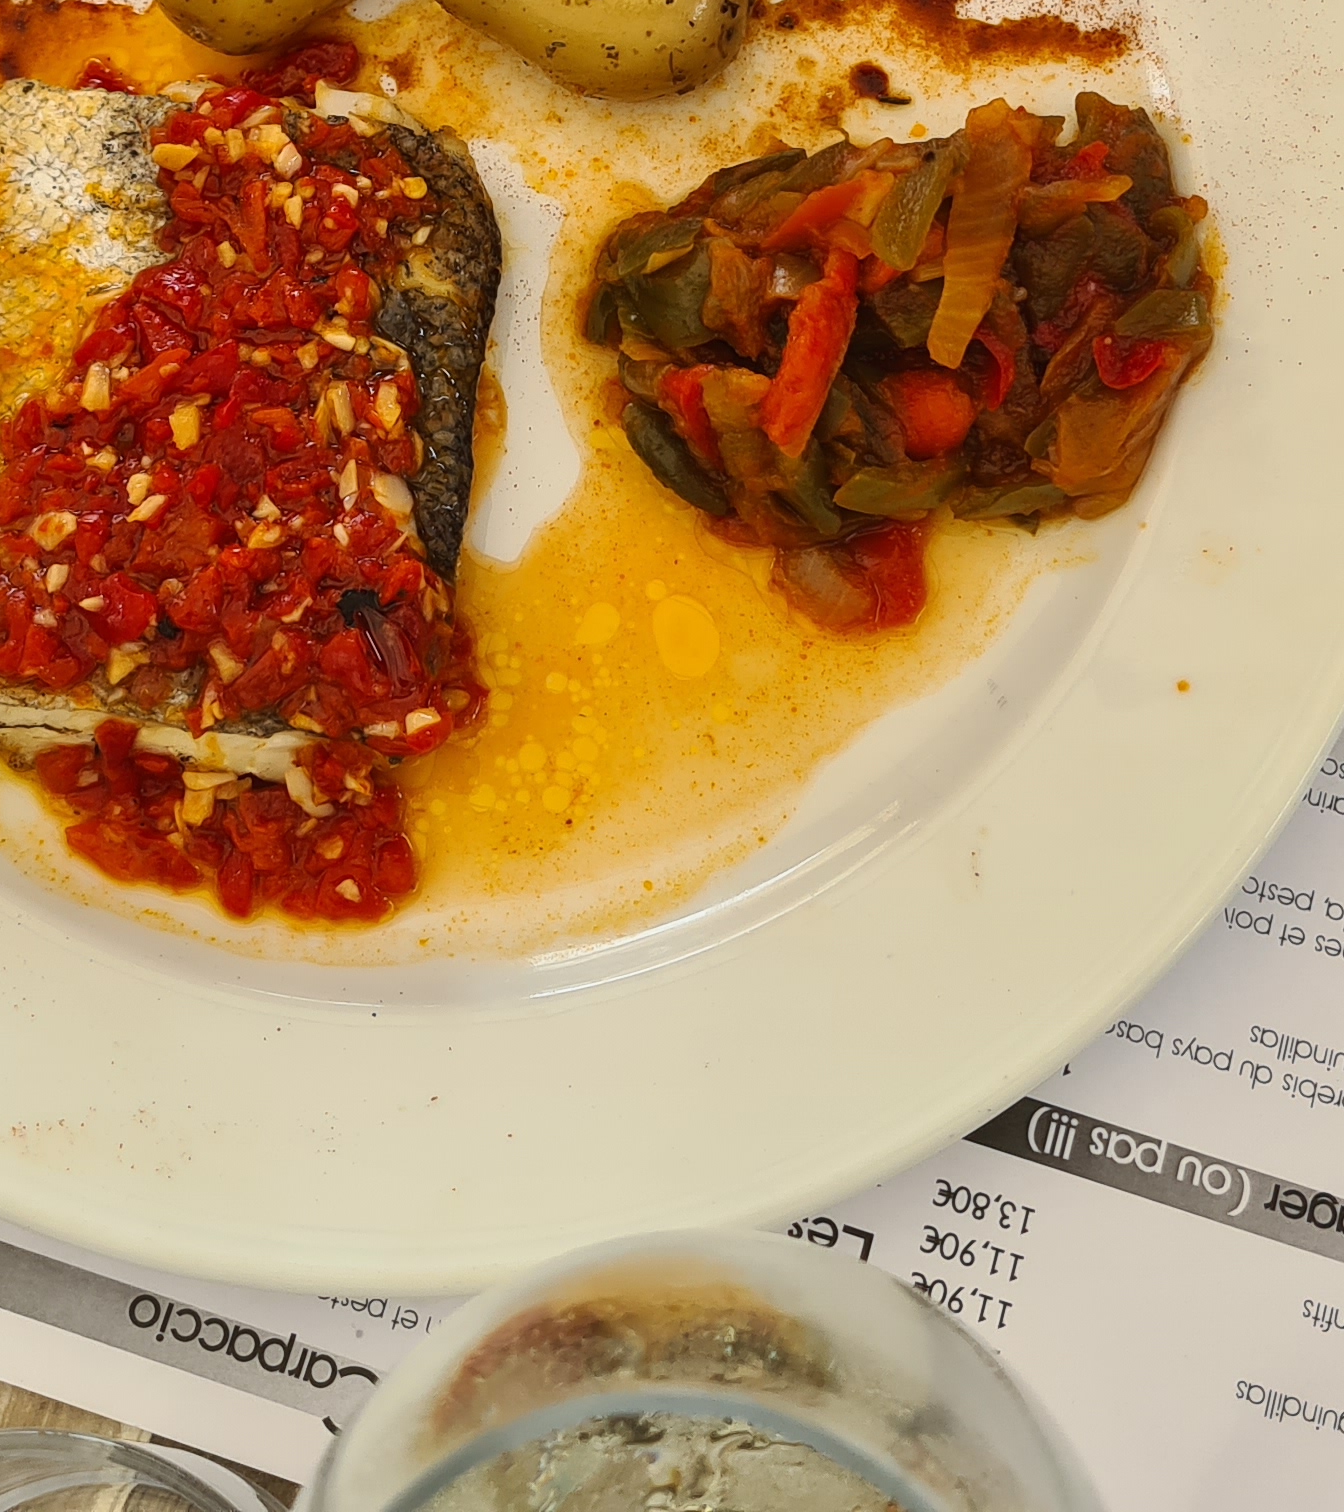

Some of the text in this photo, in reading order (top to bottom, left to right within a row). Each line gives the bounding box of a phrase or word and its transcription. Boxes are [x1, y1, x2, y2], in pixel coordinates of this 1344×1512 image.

[1172, 1037, 1234, 1072] pays
[1089, 1126, 1168, 1174] pas
[932, 1179, 1035, 1235] 13,80€
[1176, 1154, 1251, 1217] (ou
[920, 1225, 1024, 1282] 11,90€
